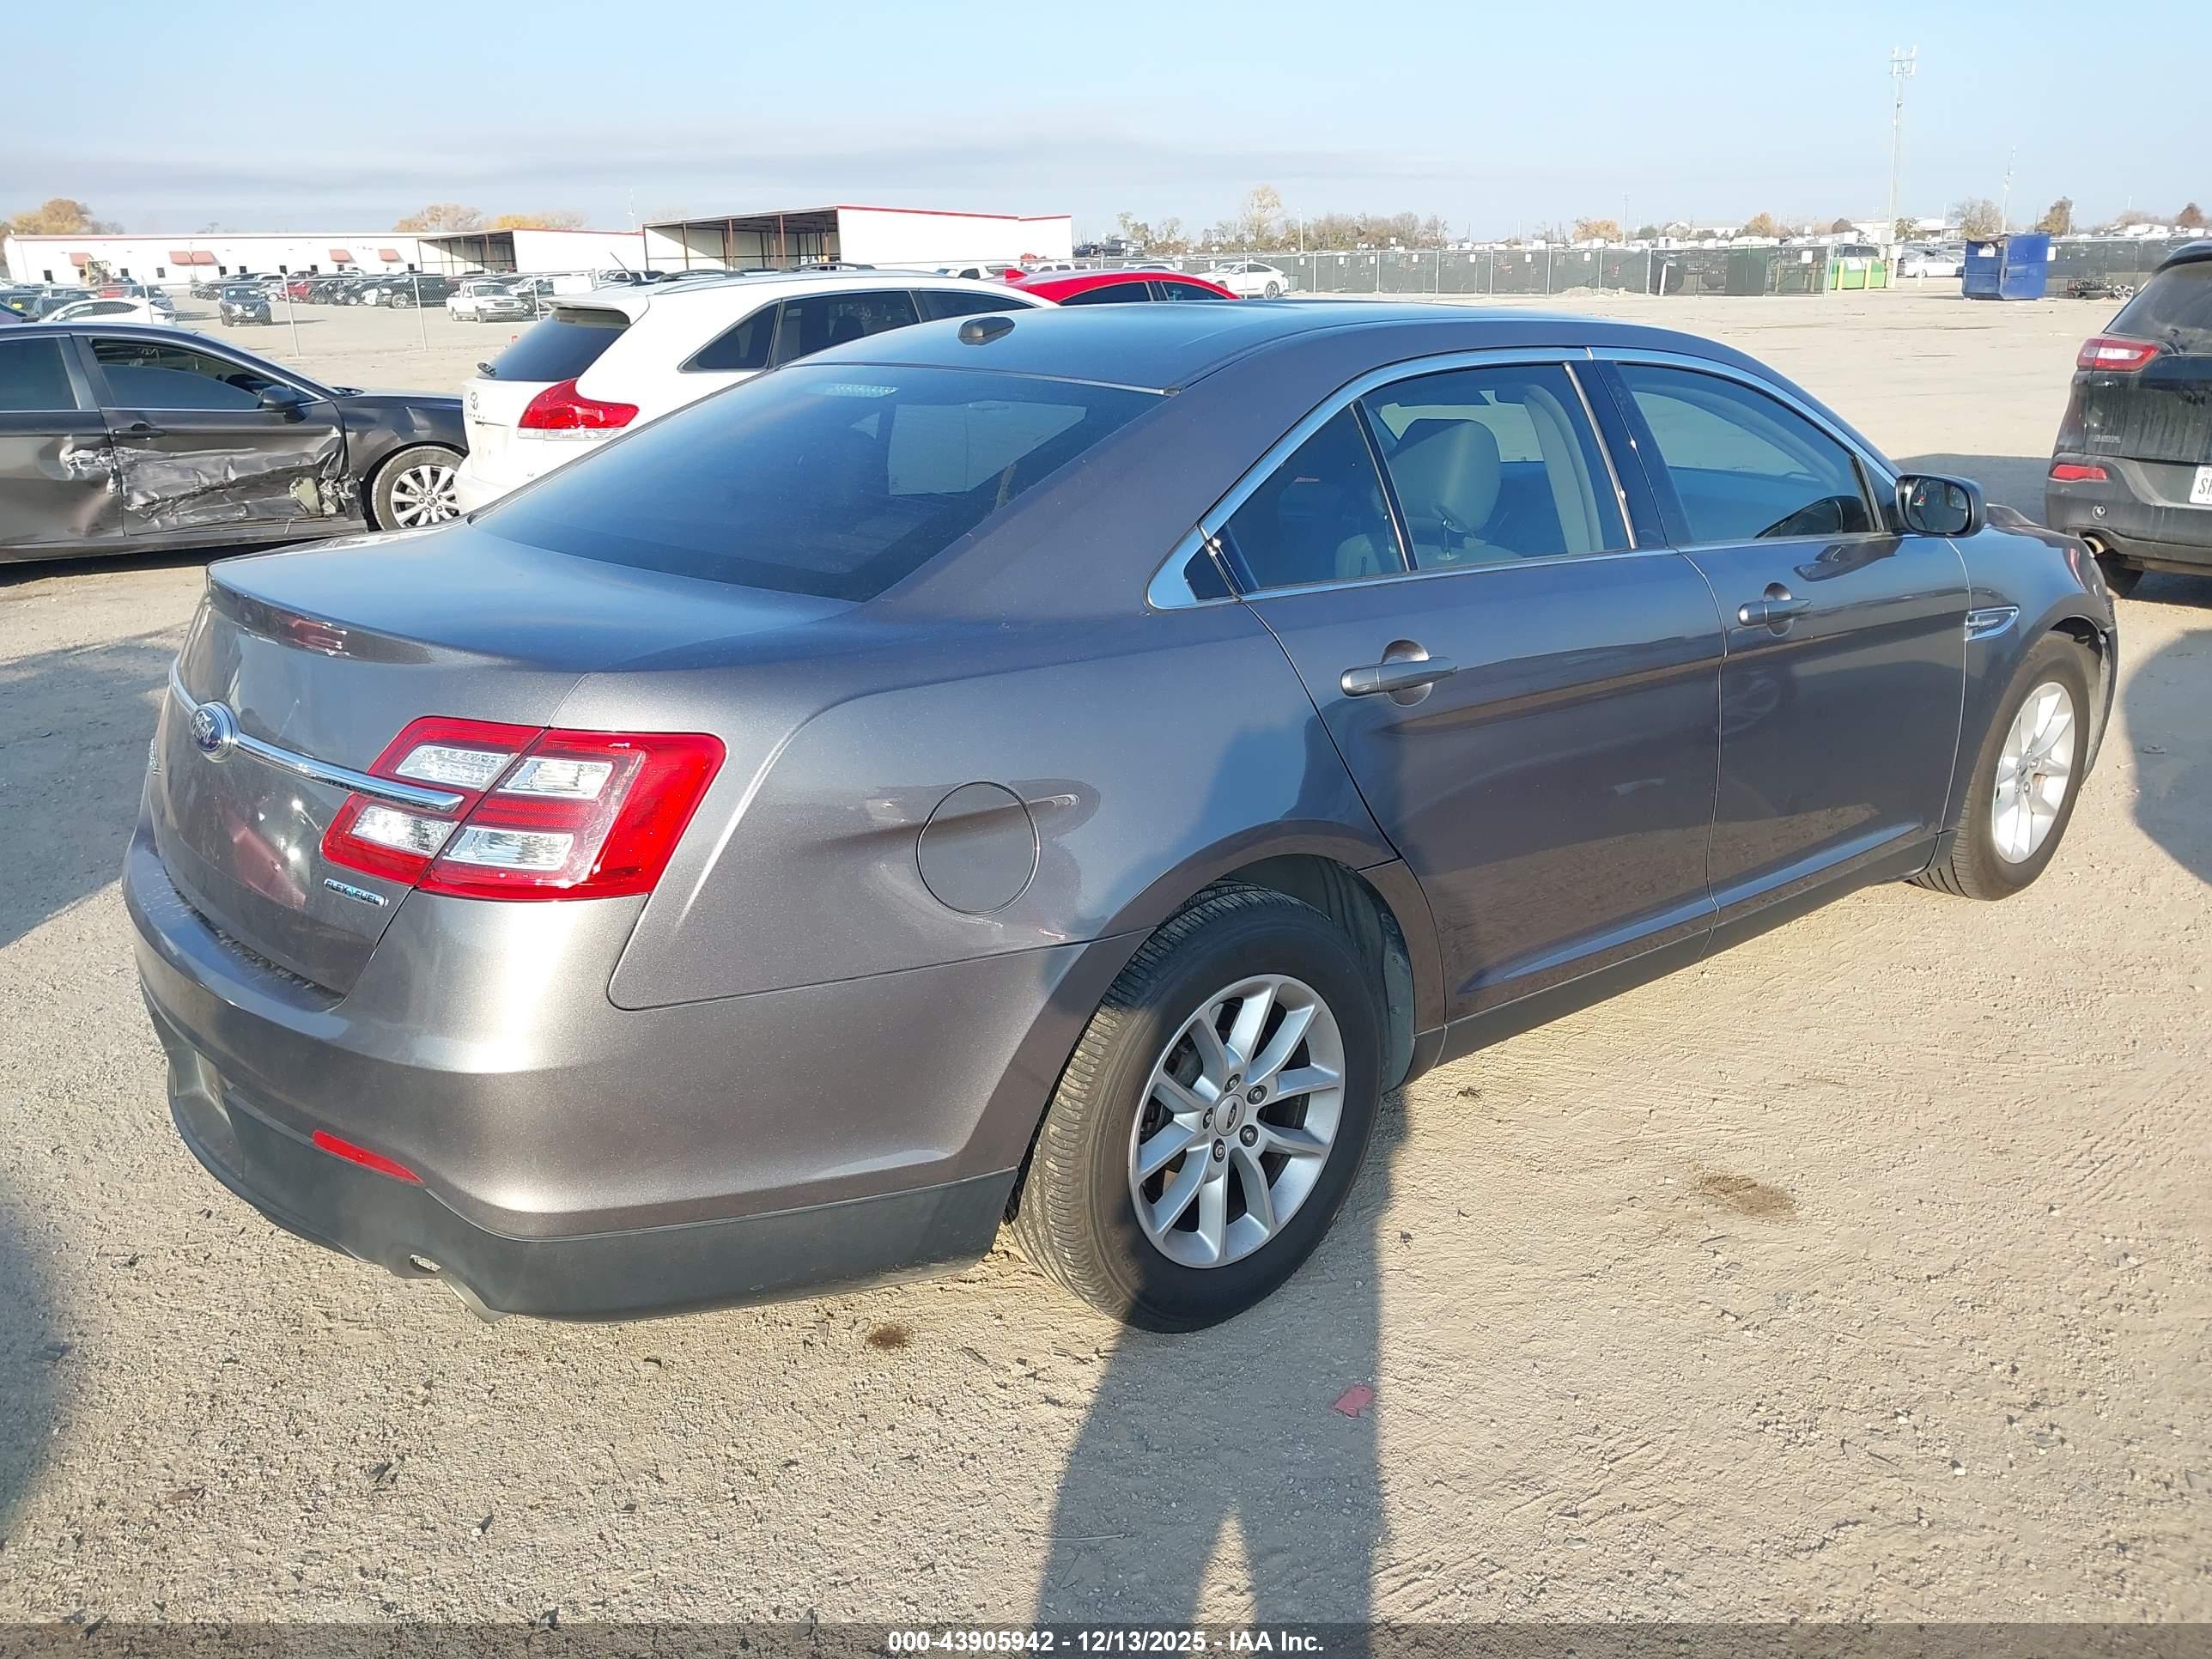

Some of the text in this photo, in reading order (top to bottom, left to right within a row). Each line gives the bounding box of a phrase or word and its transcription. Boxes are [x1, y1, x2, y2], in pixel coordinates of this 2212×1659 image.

[192, 710, 215, 744] Ford
[325, 880, 379, 905] FLEX FUEL
